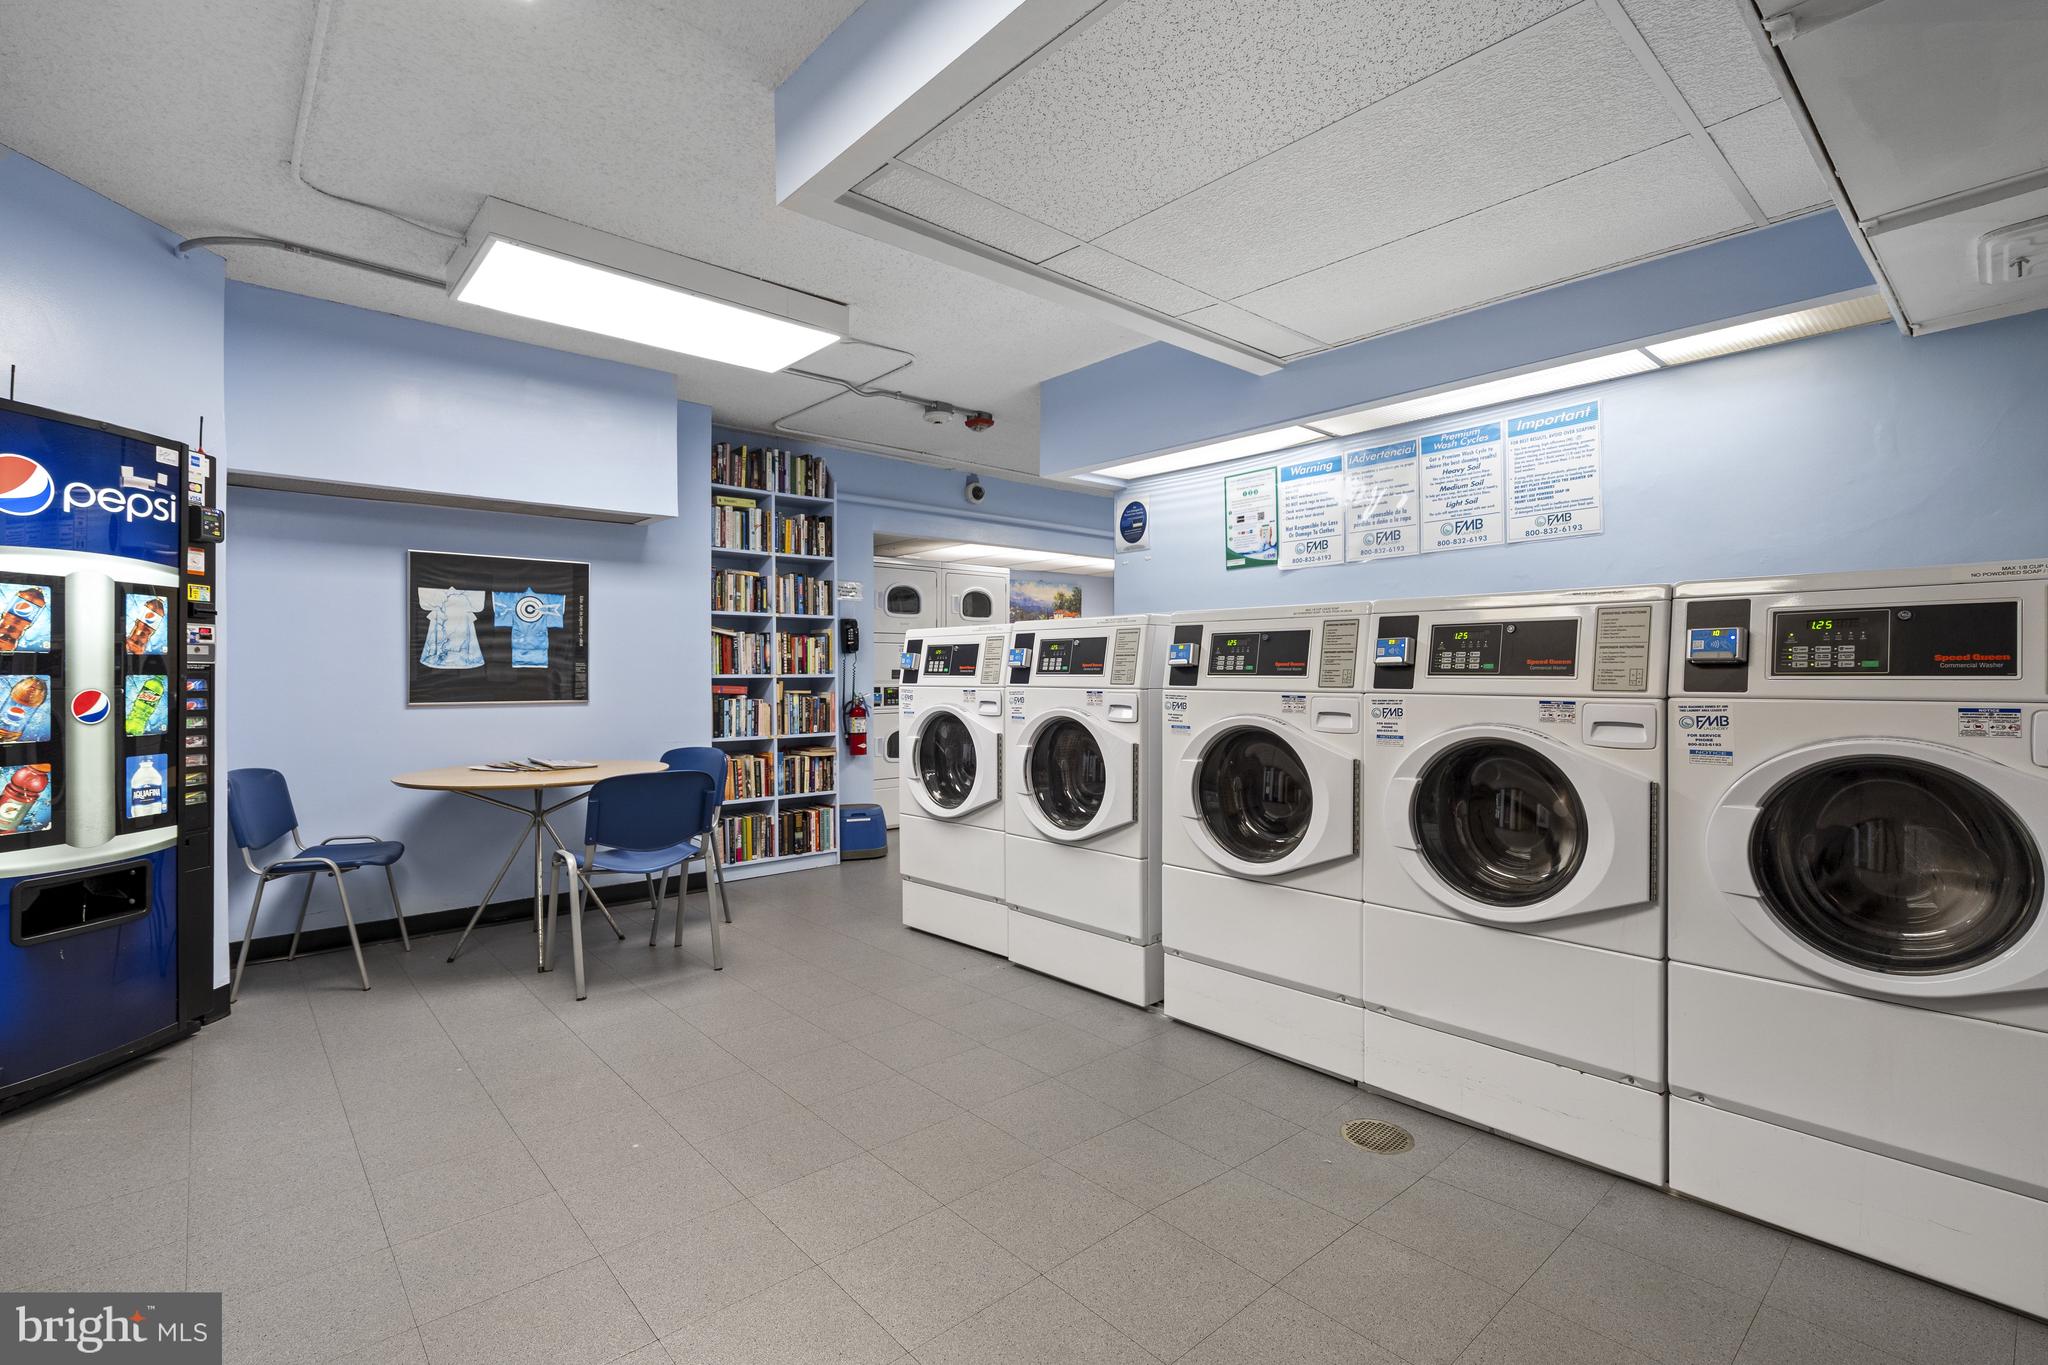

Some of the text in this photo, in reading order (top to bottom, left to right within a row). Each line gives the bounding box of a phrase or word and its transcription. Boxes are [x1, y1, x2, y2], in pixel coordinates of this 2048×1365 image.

[1517, 406, 1591, 431] Important
[1440, 428, 1480, 441] Premium
[1433, 434, 1488, 450] Wash Cycles
[1290, 461, 1333, 476] Warning
[1442, 463, 1482, 476] Heavy Soil
[1439, 479, 1484, 492] Medium Soil
[63, 482, 176, 523] pepsi
[1446, 497, 1479, 509] Light Soil
[1547, 512, 1572, 526] FMB
[1455, 518, 1484, 535] FMB
[1525, 524, 1583, 537] 800-832-6193
[1376, 530, 1401, 546] FMB
[1437, 535, 1488, 547] 800-832-6193
[1306, 540, 1329, 554] FMB
[1360, 545, 1405, 556] 800-832-6193
[1292, 554, 1331, 564] 800-832-6193
[1172, 701, 1187, 711] FMB
[1382, 708, 1403, 719] FMB
[1696, 715, 1729, 729] FMB
[133, 788, 161, 800] AQUAFINA
